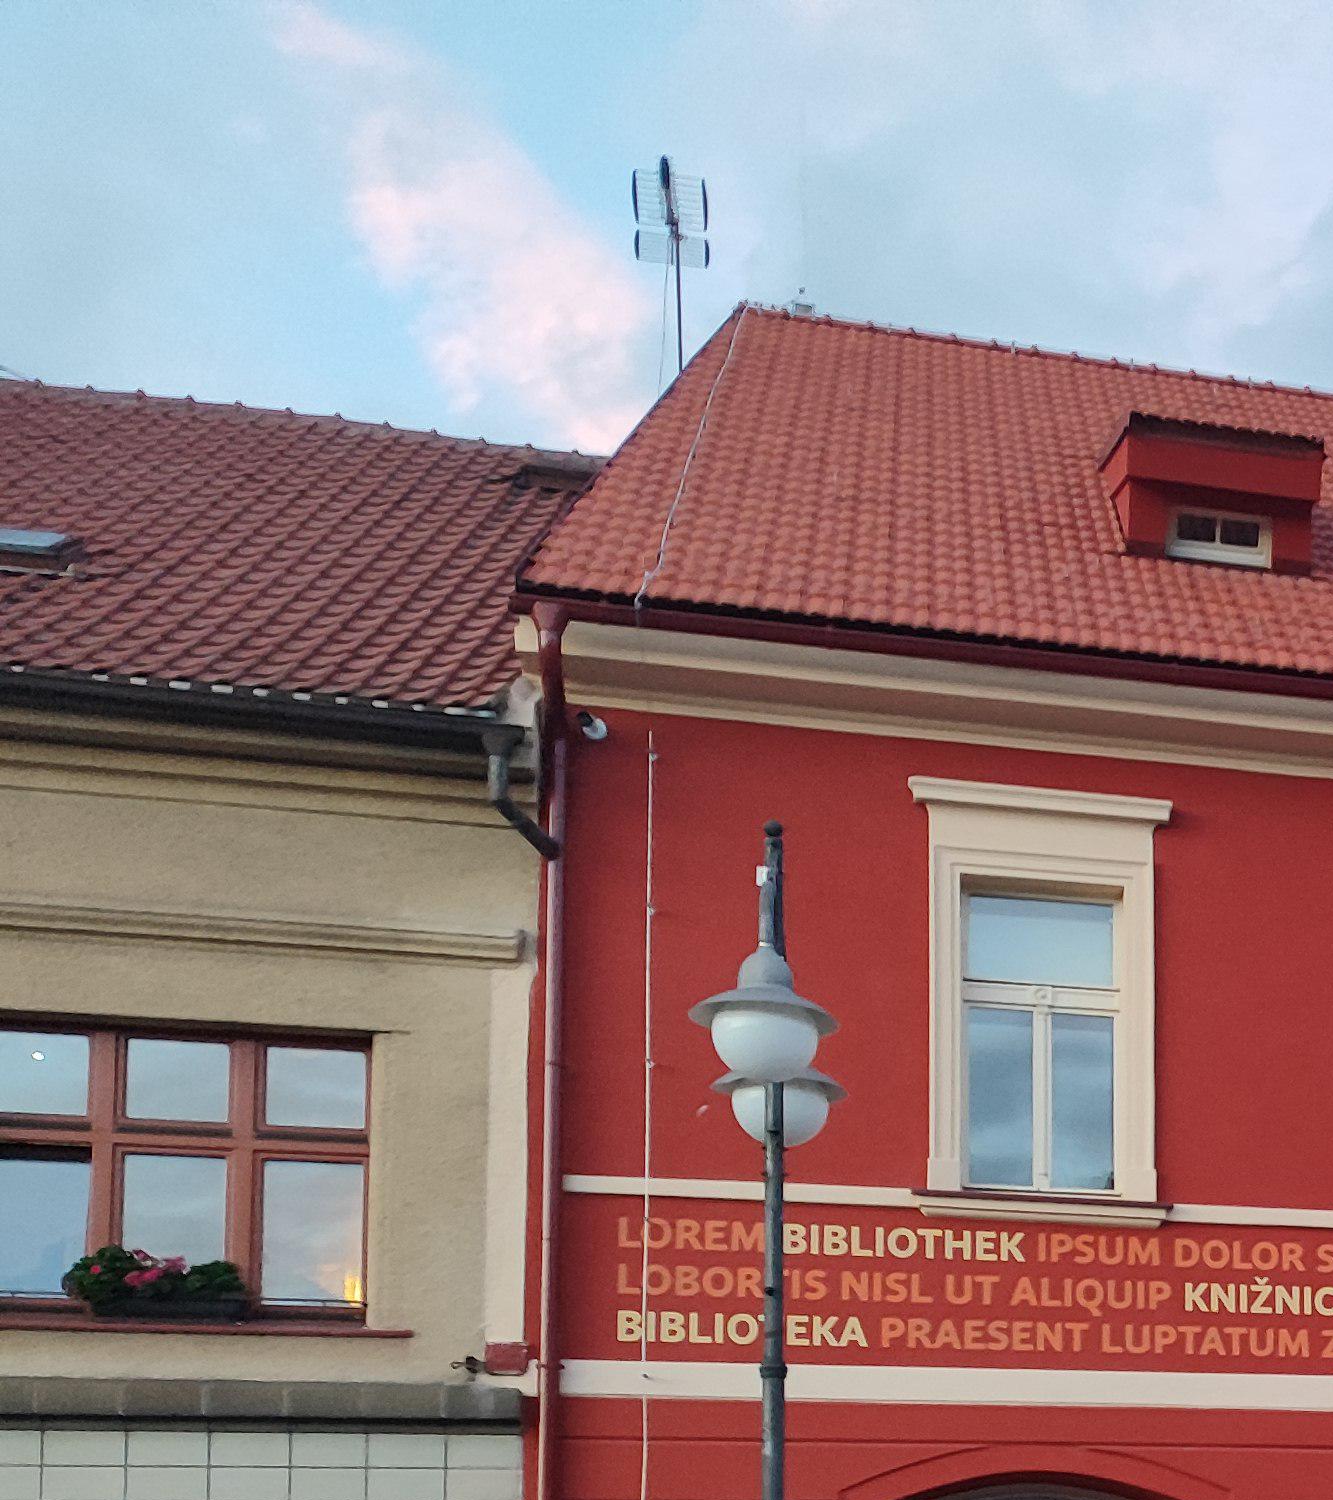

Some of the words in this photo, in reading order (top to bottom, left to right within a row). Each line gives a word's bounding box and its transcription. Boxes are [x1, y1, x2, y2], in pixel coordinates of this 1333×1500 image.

[618, 1217, 765, 1253] LOREM
[783, 1223, 1025, 1262] BIBLIOTHEK
[1038, 1233, 1160, 1265] IPSUM
[1175, 1238, 1305, 1271] DOLOR
[617, 1263, 827, 1301] LOBORIS
[841, 1271, 933, 1303] NISL
[945, 1274, 1000, 1305] UT
[1010, 1277, 1172, 1314] ALIQUIP
[617, 1309, 868, 1347] BIBLIOEKA
[881, 1318, 1089, 1352] PRAESENT
[1102, 1324, 1309, 1357] LUPTATUM
